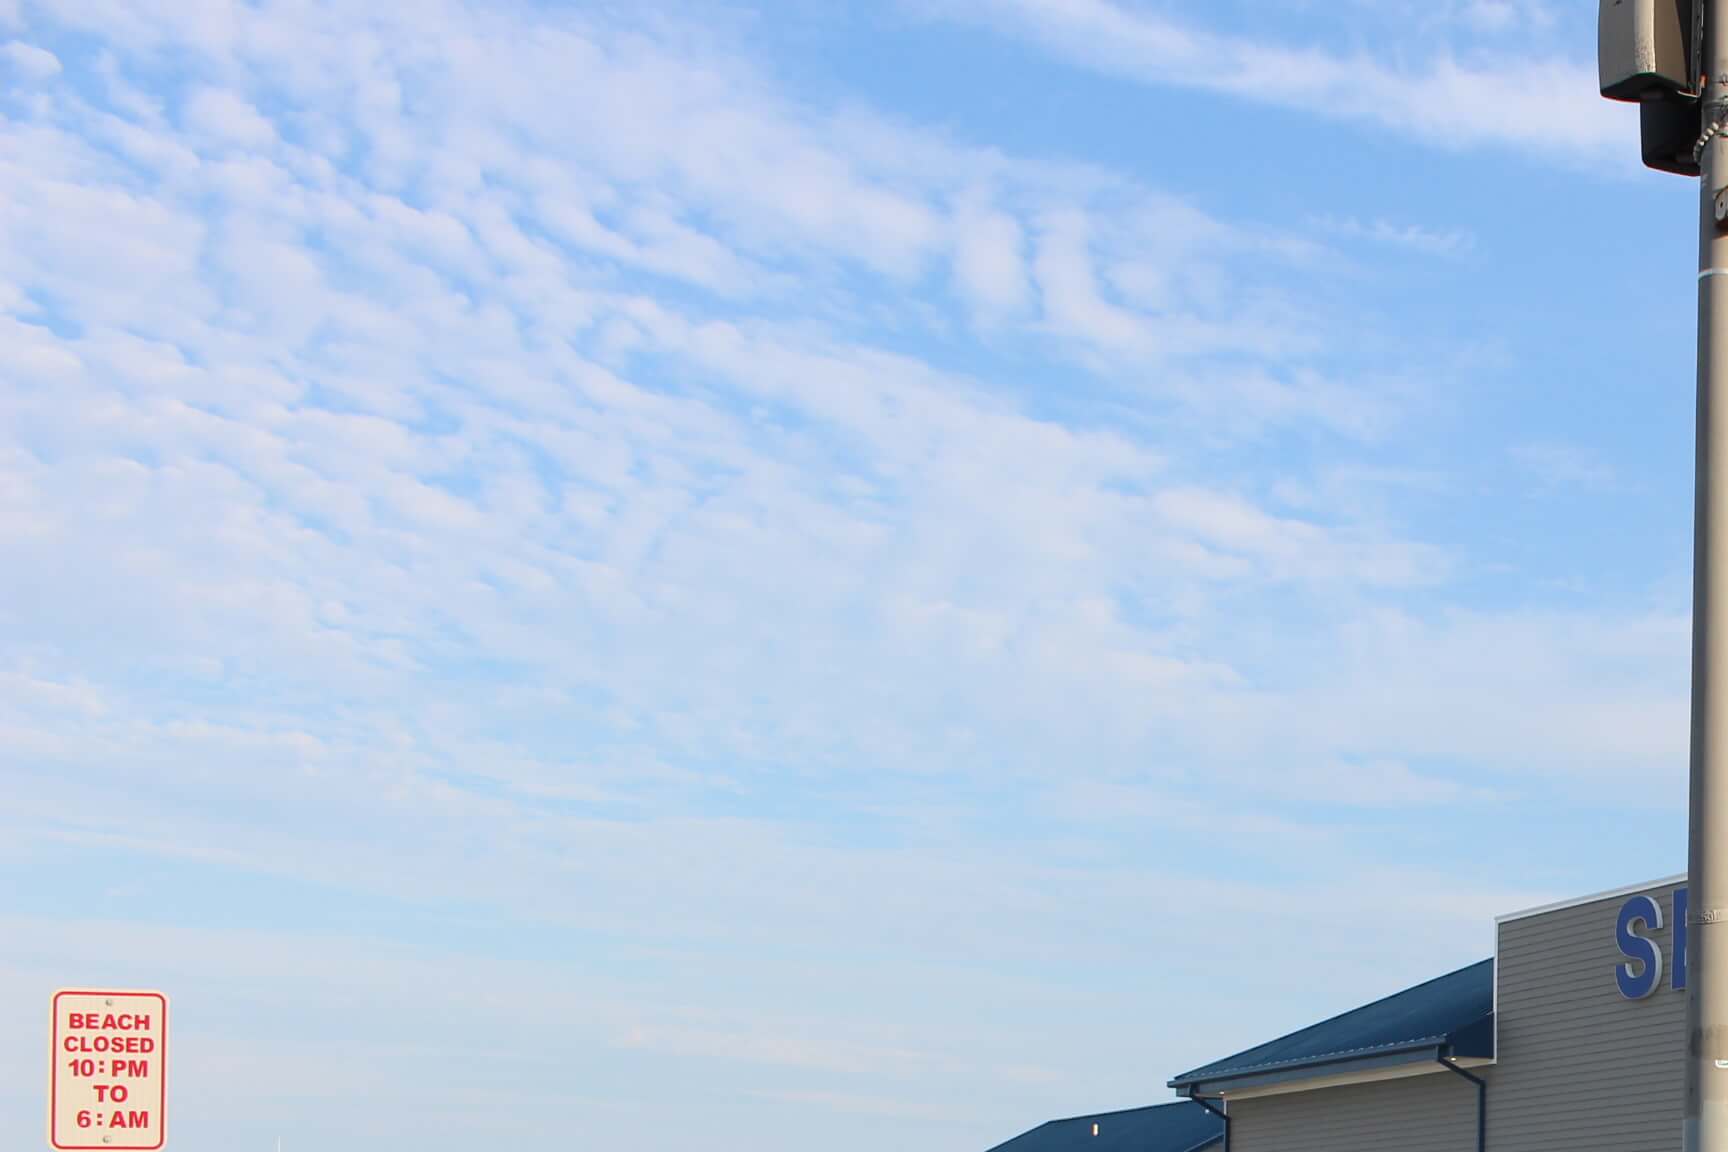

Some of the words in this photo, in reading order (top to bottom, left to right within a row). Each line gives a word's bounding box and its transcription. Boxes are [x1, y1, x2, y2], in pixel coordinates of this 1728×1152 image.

[68, 1013, 150, 1031] BEACH
[63, 1035, 155, 1054] CLOSED
[92, 1084, 128, 1103] TO
